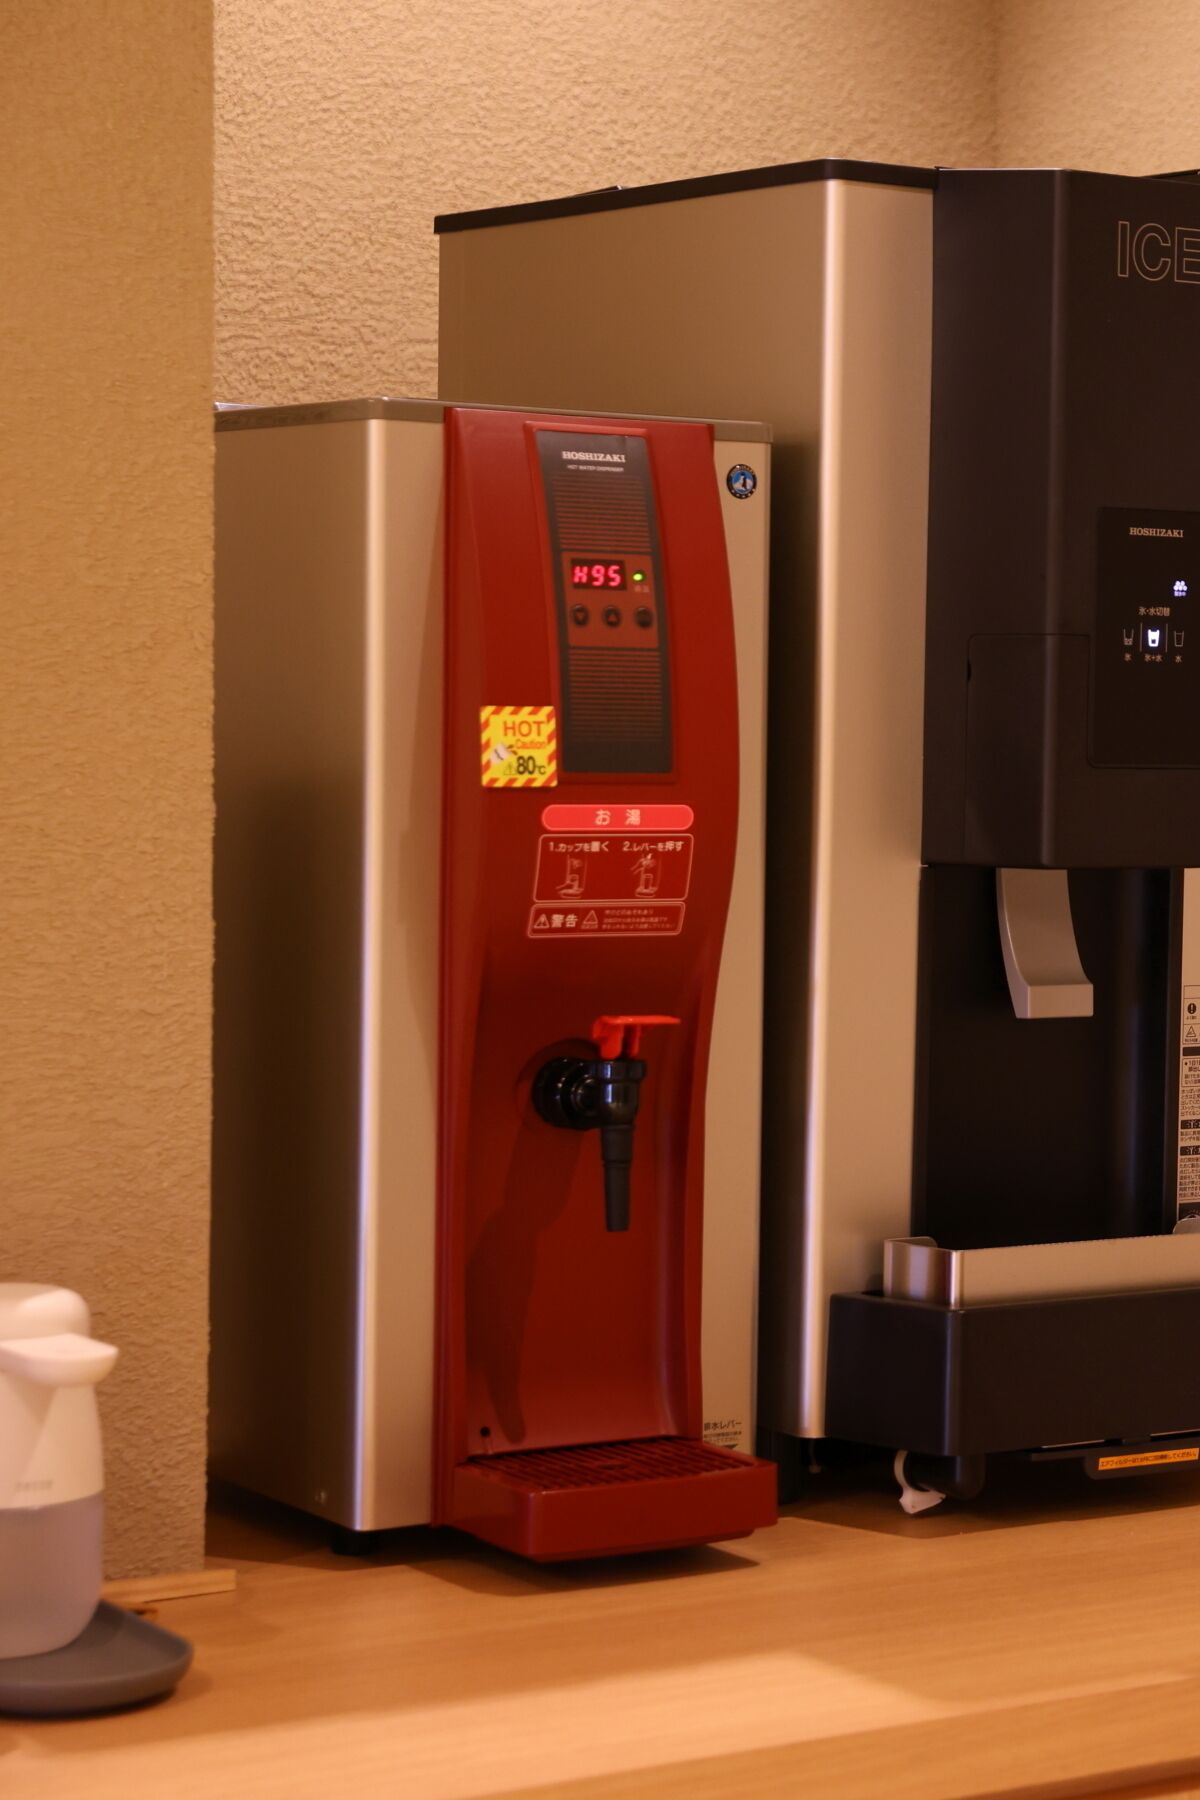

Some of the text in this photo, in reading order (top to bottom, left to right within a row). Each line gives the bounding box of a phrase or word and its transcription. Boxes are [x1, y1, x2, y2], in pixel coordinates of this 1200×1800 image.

[562, 451, 626, 463] HOSHIZAKI
[1129, 527, 1184, 538] HOSHIZAKI
[573, 564, 621, 587] H95
[503, 720, 546, 737] HOT
[515, 739, 546, 749] Caution
[551, 914, 578, 928] 警告
